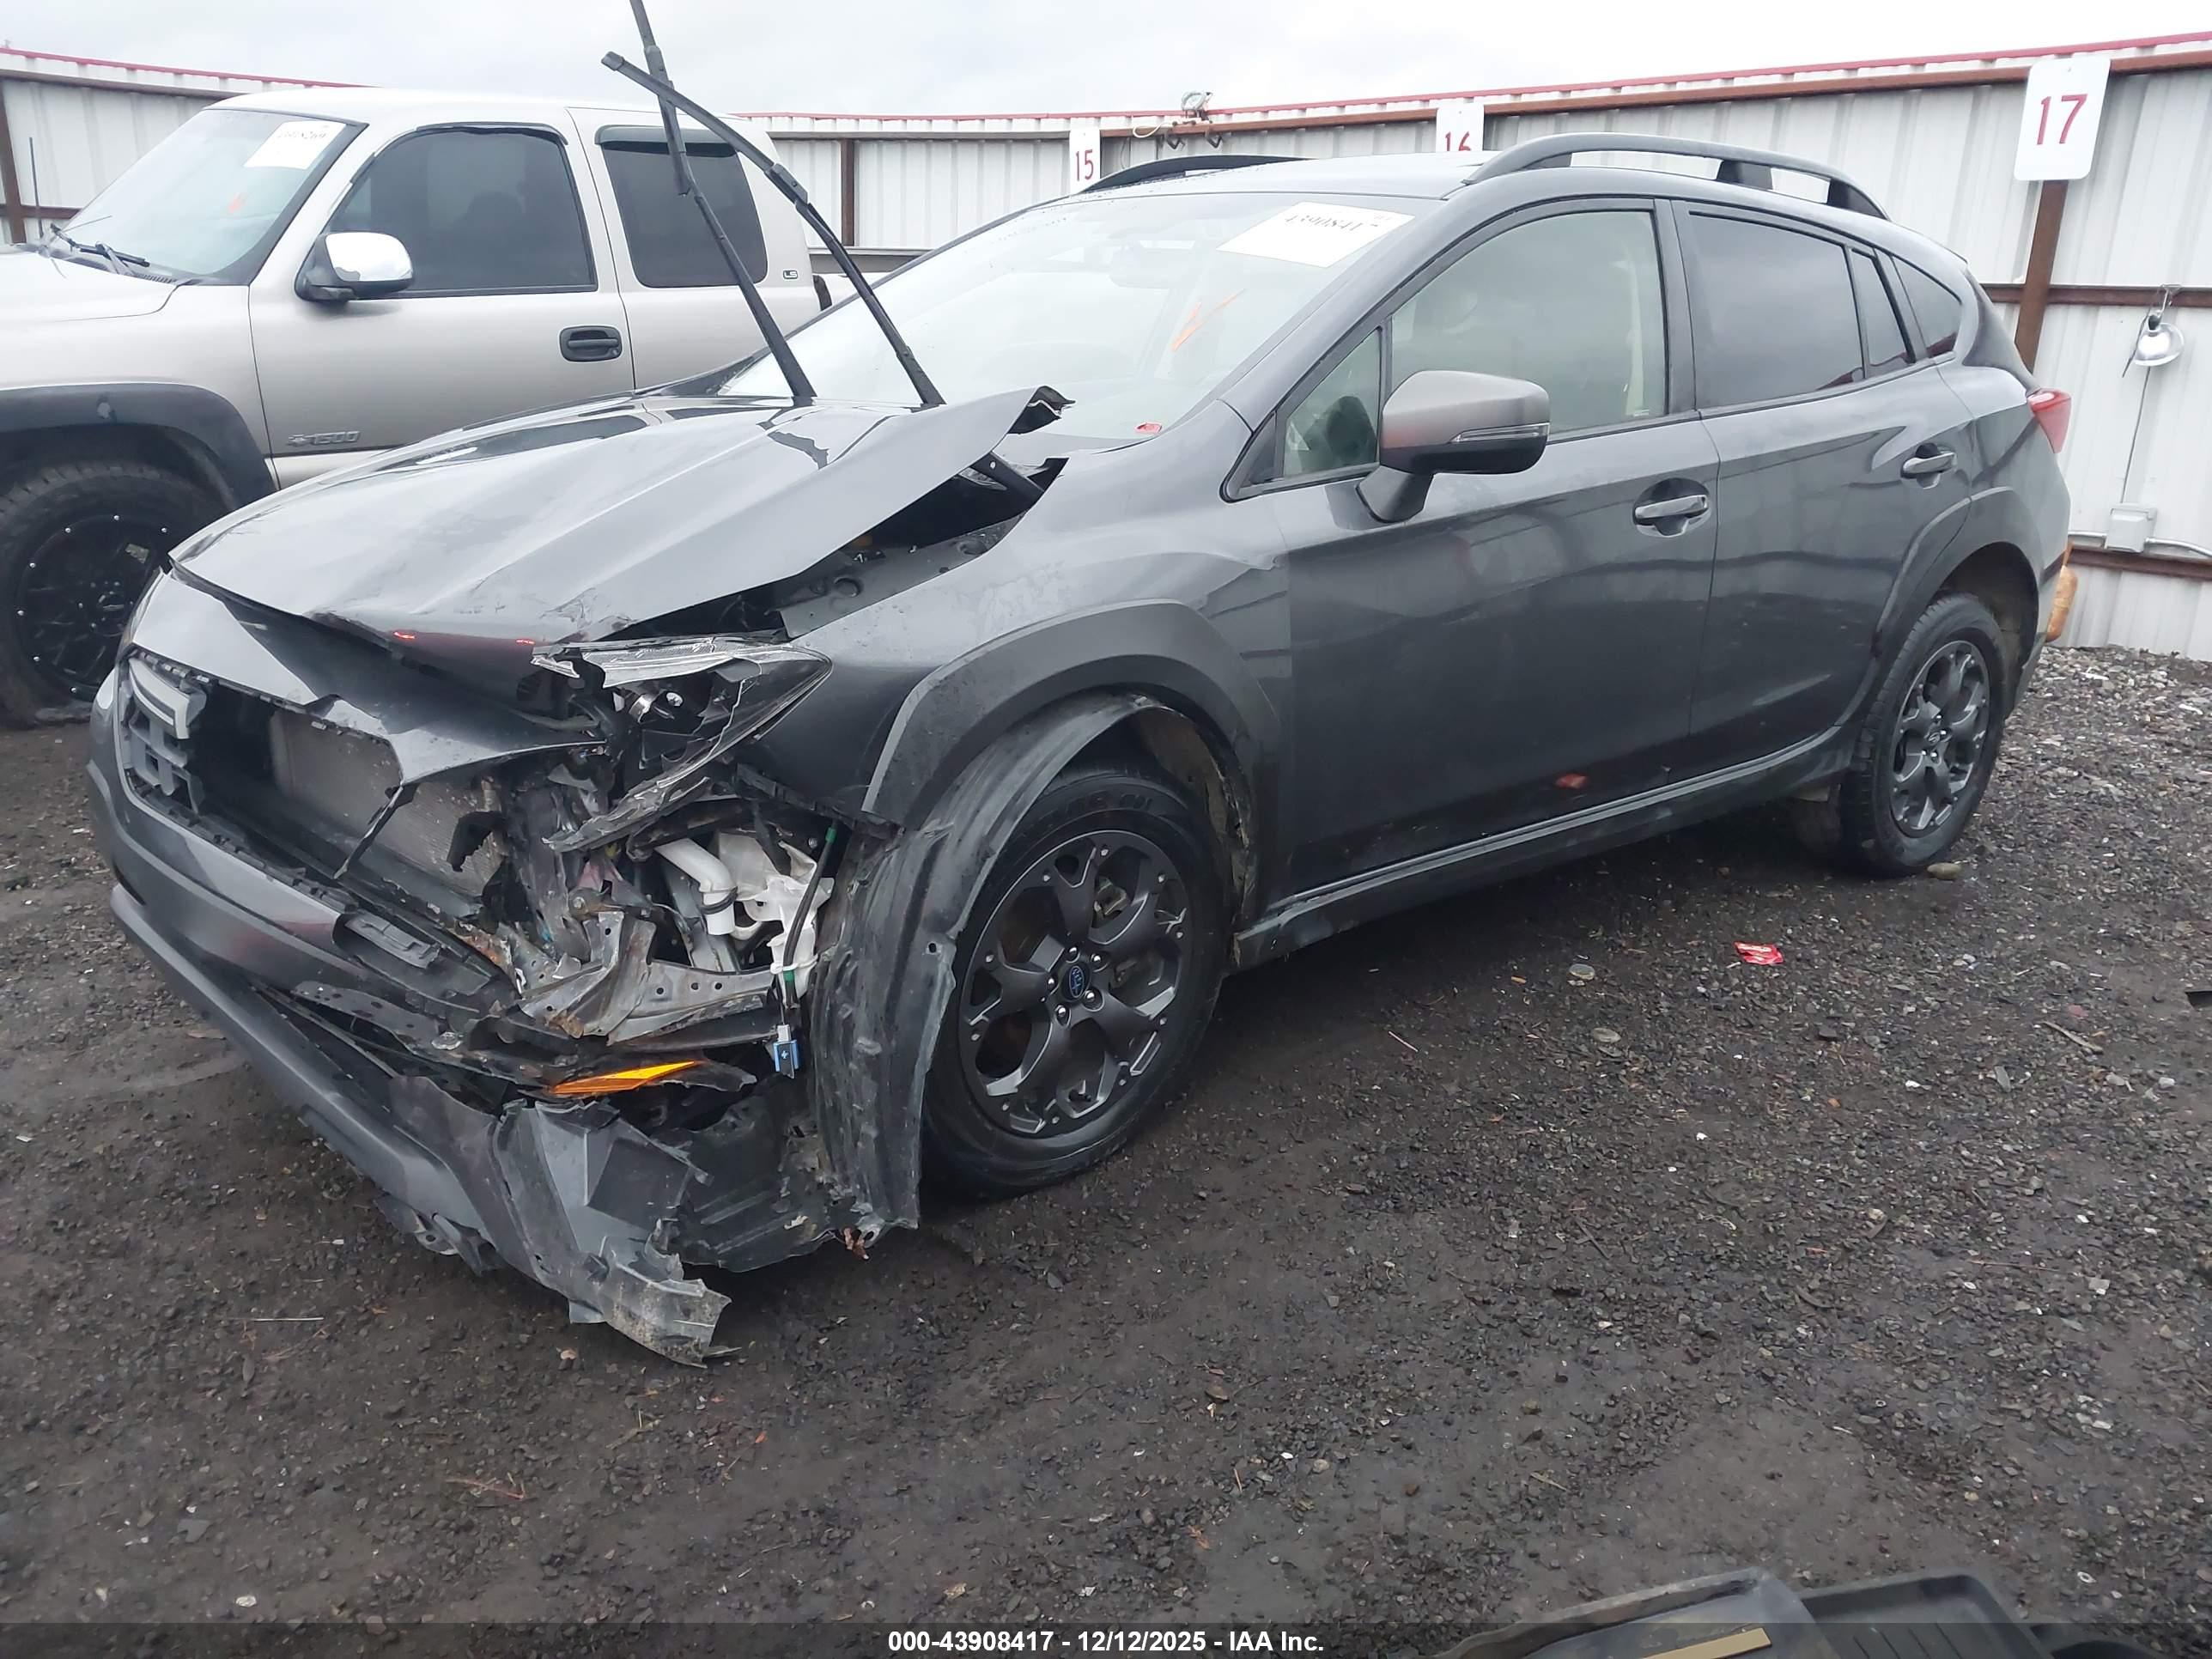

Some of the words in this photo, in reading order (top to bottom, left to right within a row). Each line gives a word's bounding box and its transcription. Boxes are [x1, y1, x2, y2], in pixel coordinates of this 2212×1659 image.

[2037, 94, 2087, 145] 17
[1076, 149, 1093, 181] 15
[783, 270, 798, 279] LS
